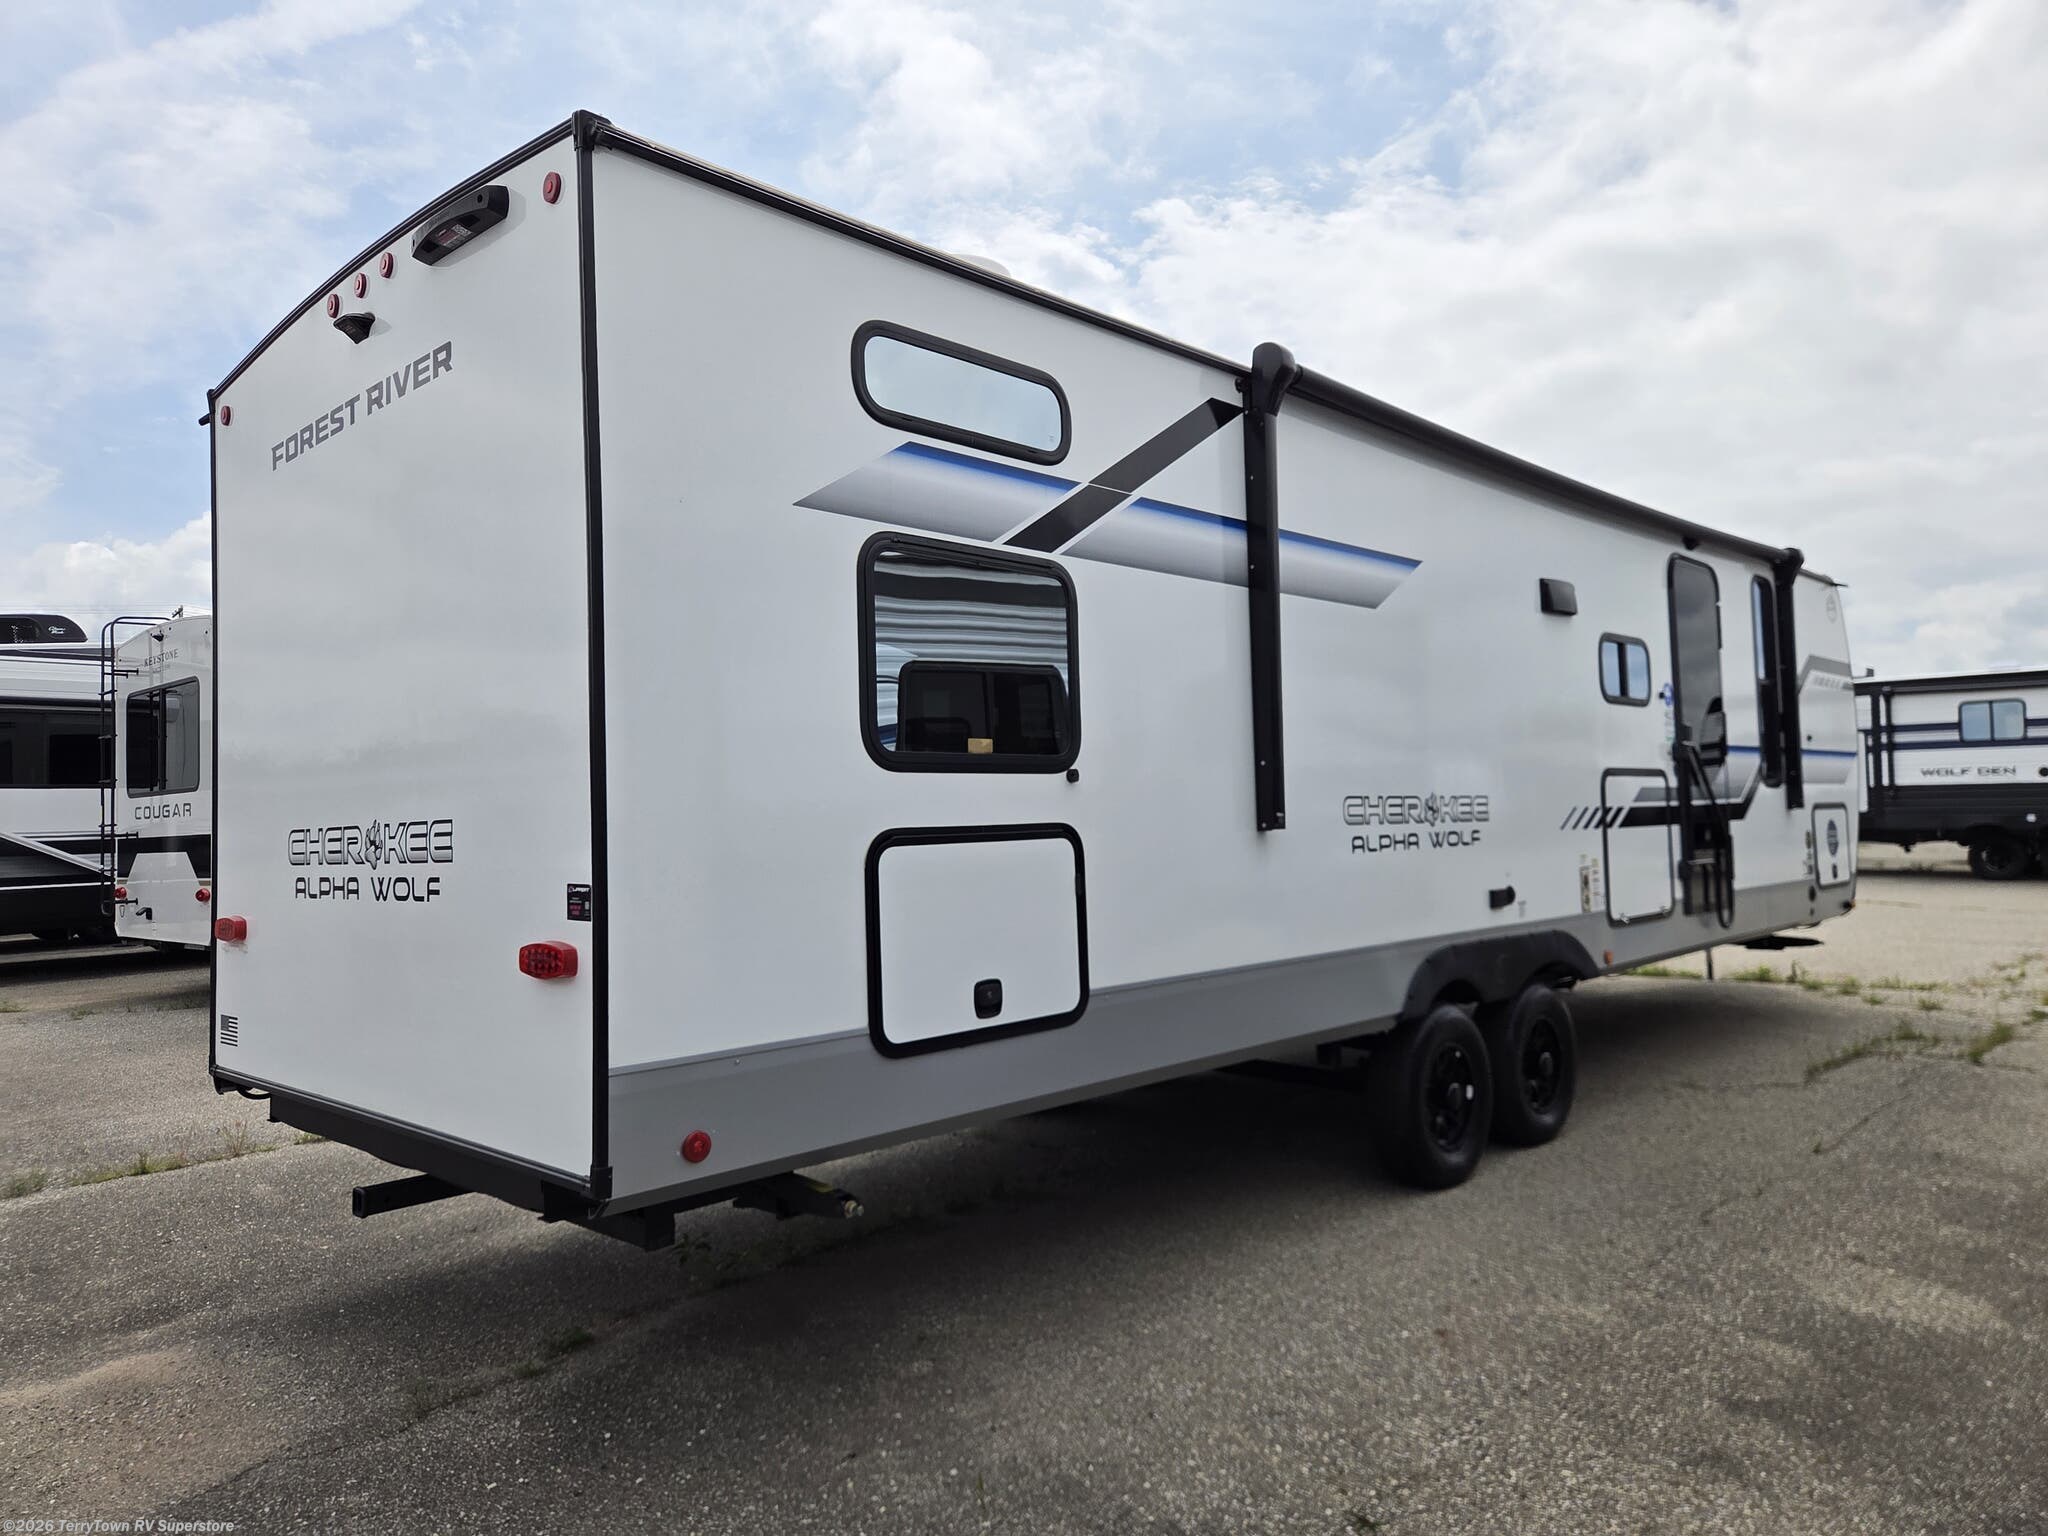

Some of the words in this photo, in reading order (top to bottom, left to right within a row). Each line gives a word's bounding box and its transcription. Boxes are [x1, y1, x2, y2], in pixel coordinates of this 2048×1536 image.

[271, 394, 360, 472] FOREST
[365, 340, 453, 416] RIVER
[134, 802, 192, 820] COUGAR
[1352, 833, 1419, 854] ALPHA
[1429, 829, 1481, 849] WOLF
[295, 876, 360, 900] ALPHA
[370, 876, 441, 902] WOLF
